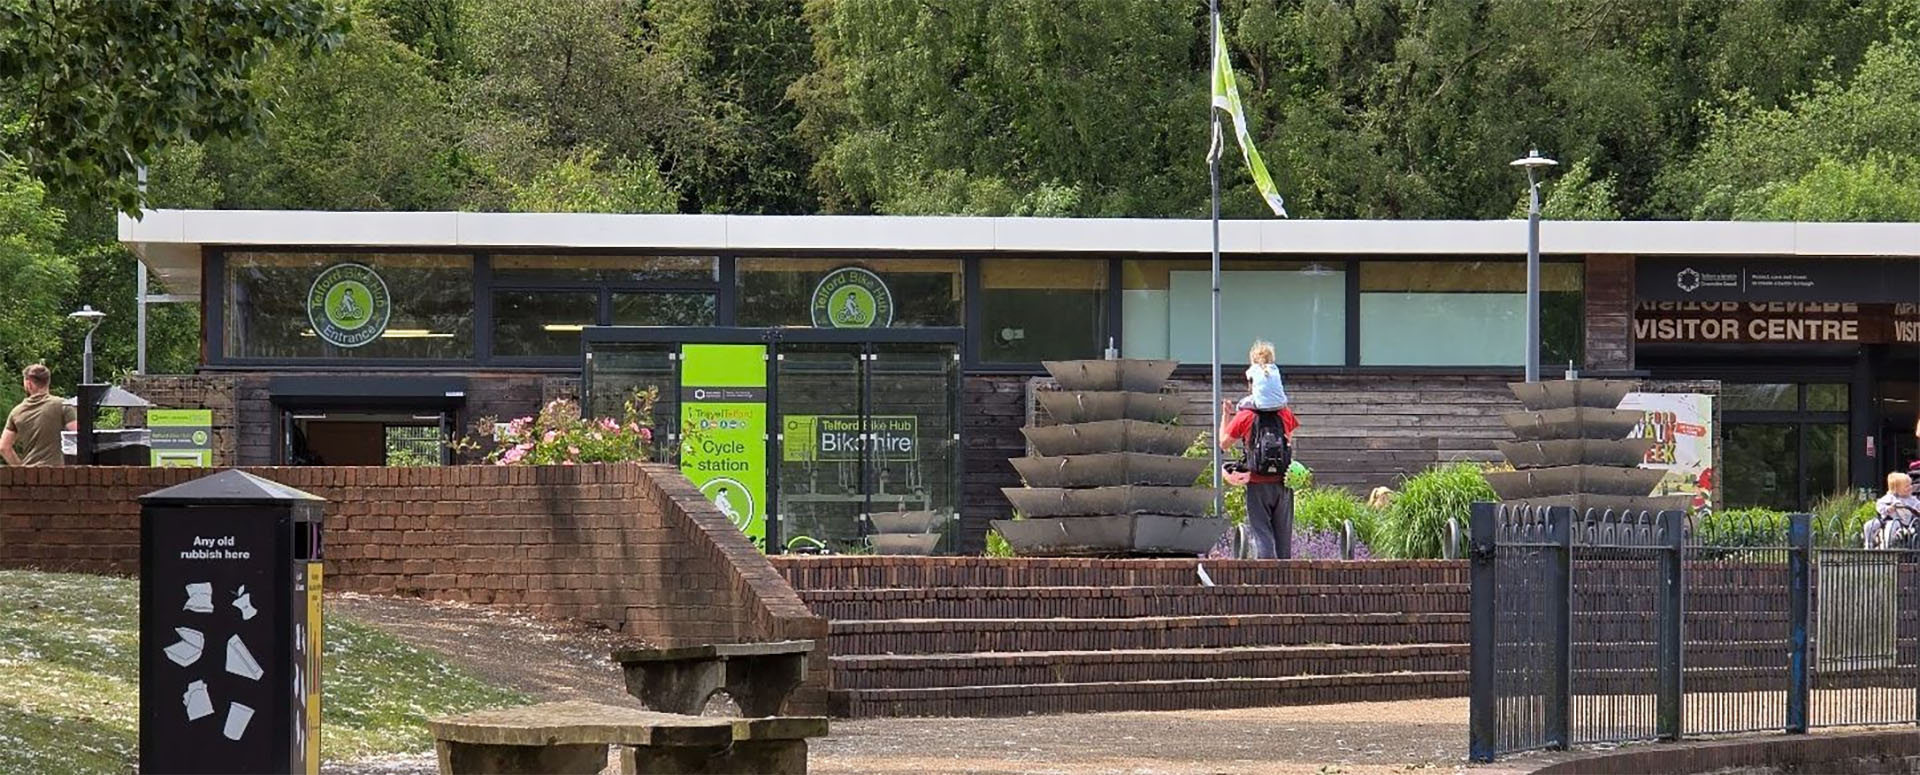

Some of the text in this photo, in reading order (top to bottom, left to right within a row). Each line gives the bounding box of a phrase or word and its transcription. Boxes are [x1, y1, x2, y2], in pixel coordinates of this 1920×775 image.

[311, 269, 341, 309] Telford
[815, 271, 887, 313] Telford Bike Hub
[323, 324, 377, 343] Entrance
[1634, 319, 1859, 341] VISITOR CENTRE
[822, 420, 860, 431] Telford
[889, 420, 912, 431] Hub
[702, 440, 745, 456] Cycle
[872, 432, 912, 452] hire
[697, 458, 749, 471] station
[193, 535, 235, 548] Any old
[180, 549, 250, 559] rubbish here
